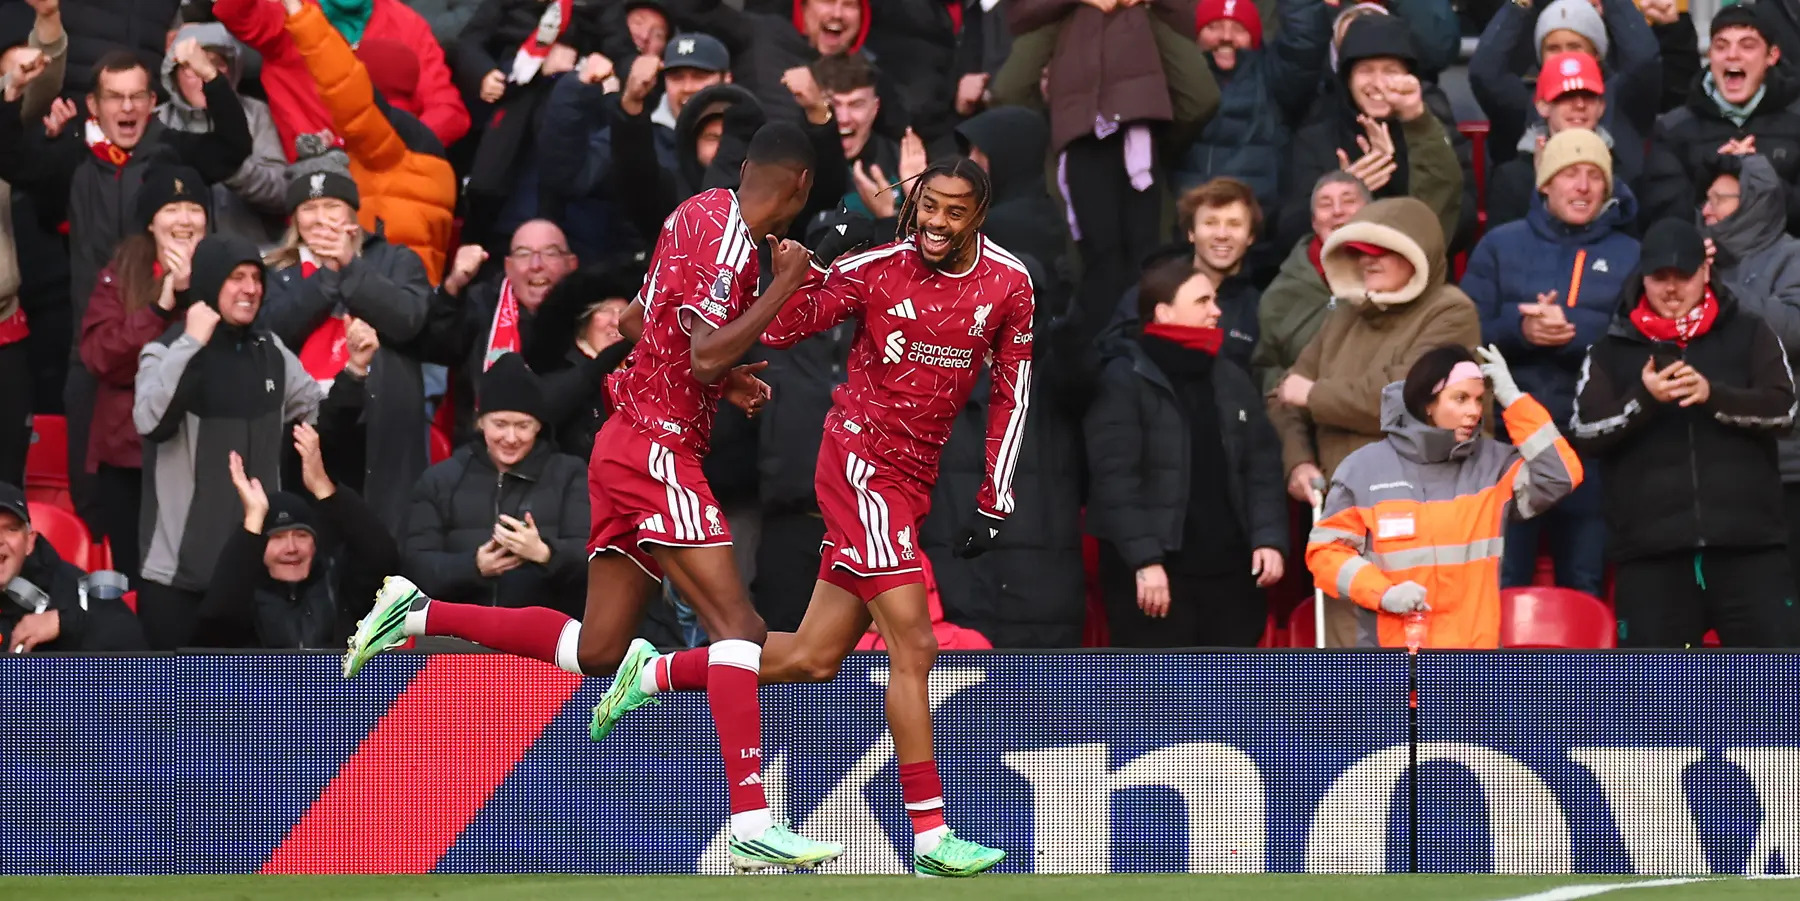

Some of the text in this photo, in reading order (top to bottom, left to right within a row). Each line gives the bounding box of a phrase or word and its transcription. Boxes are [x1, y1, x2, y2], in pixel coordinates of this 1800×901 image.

[968, 328, 984, 337] LFC
[910, 341, 973, 358] standard
[907, 351, 972, 368] chartered
